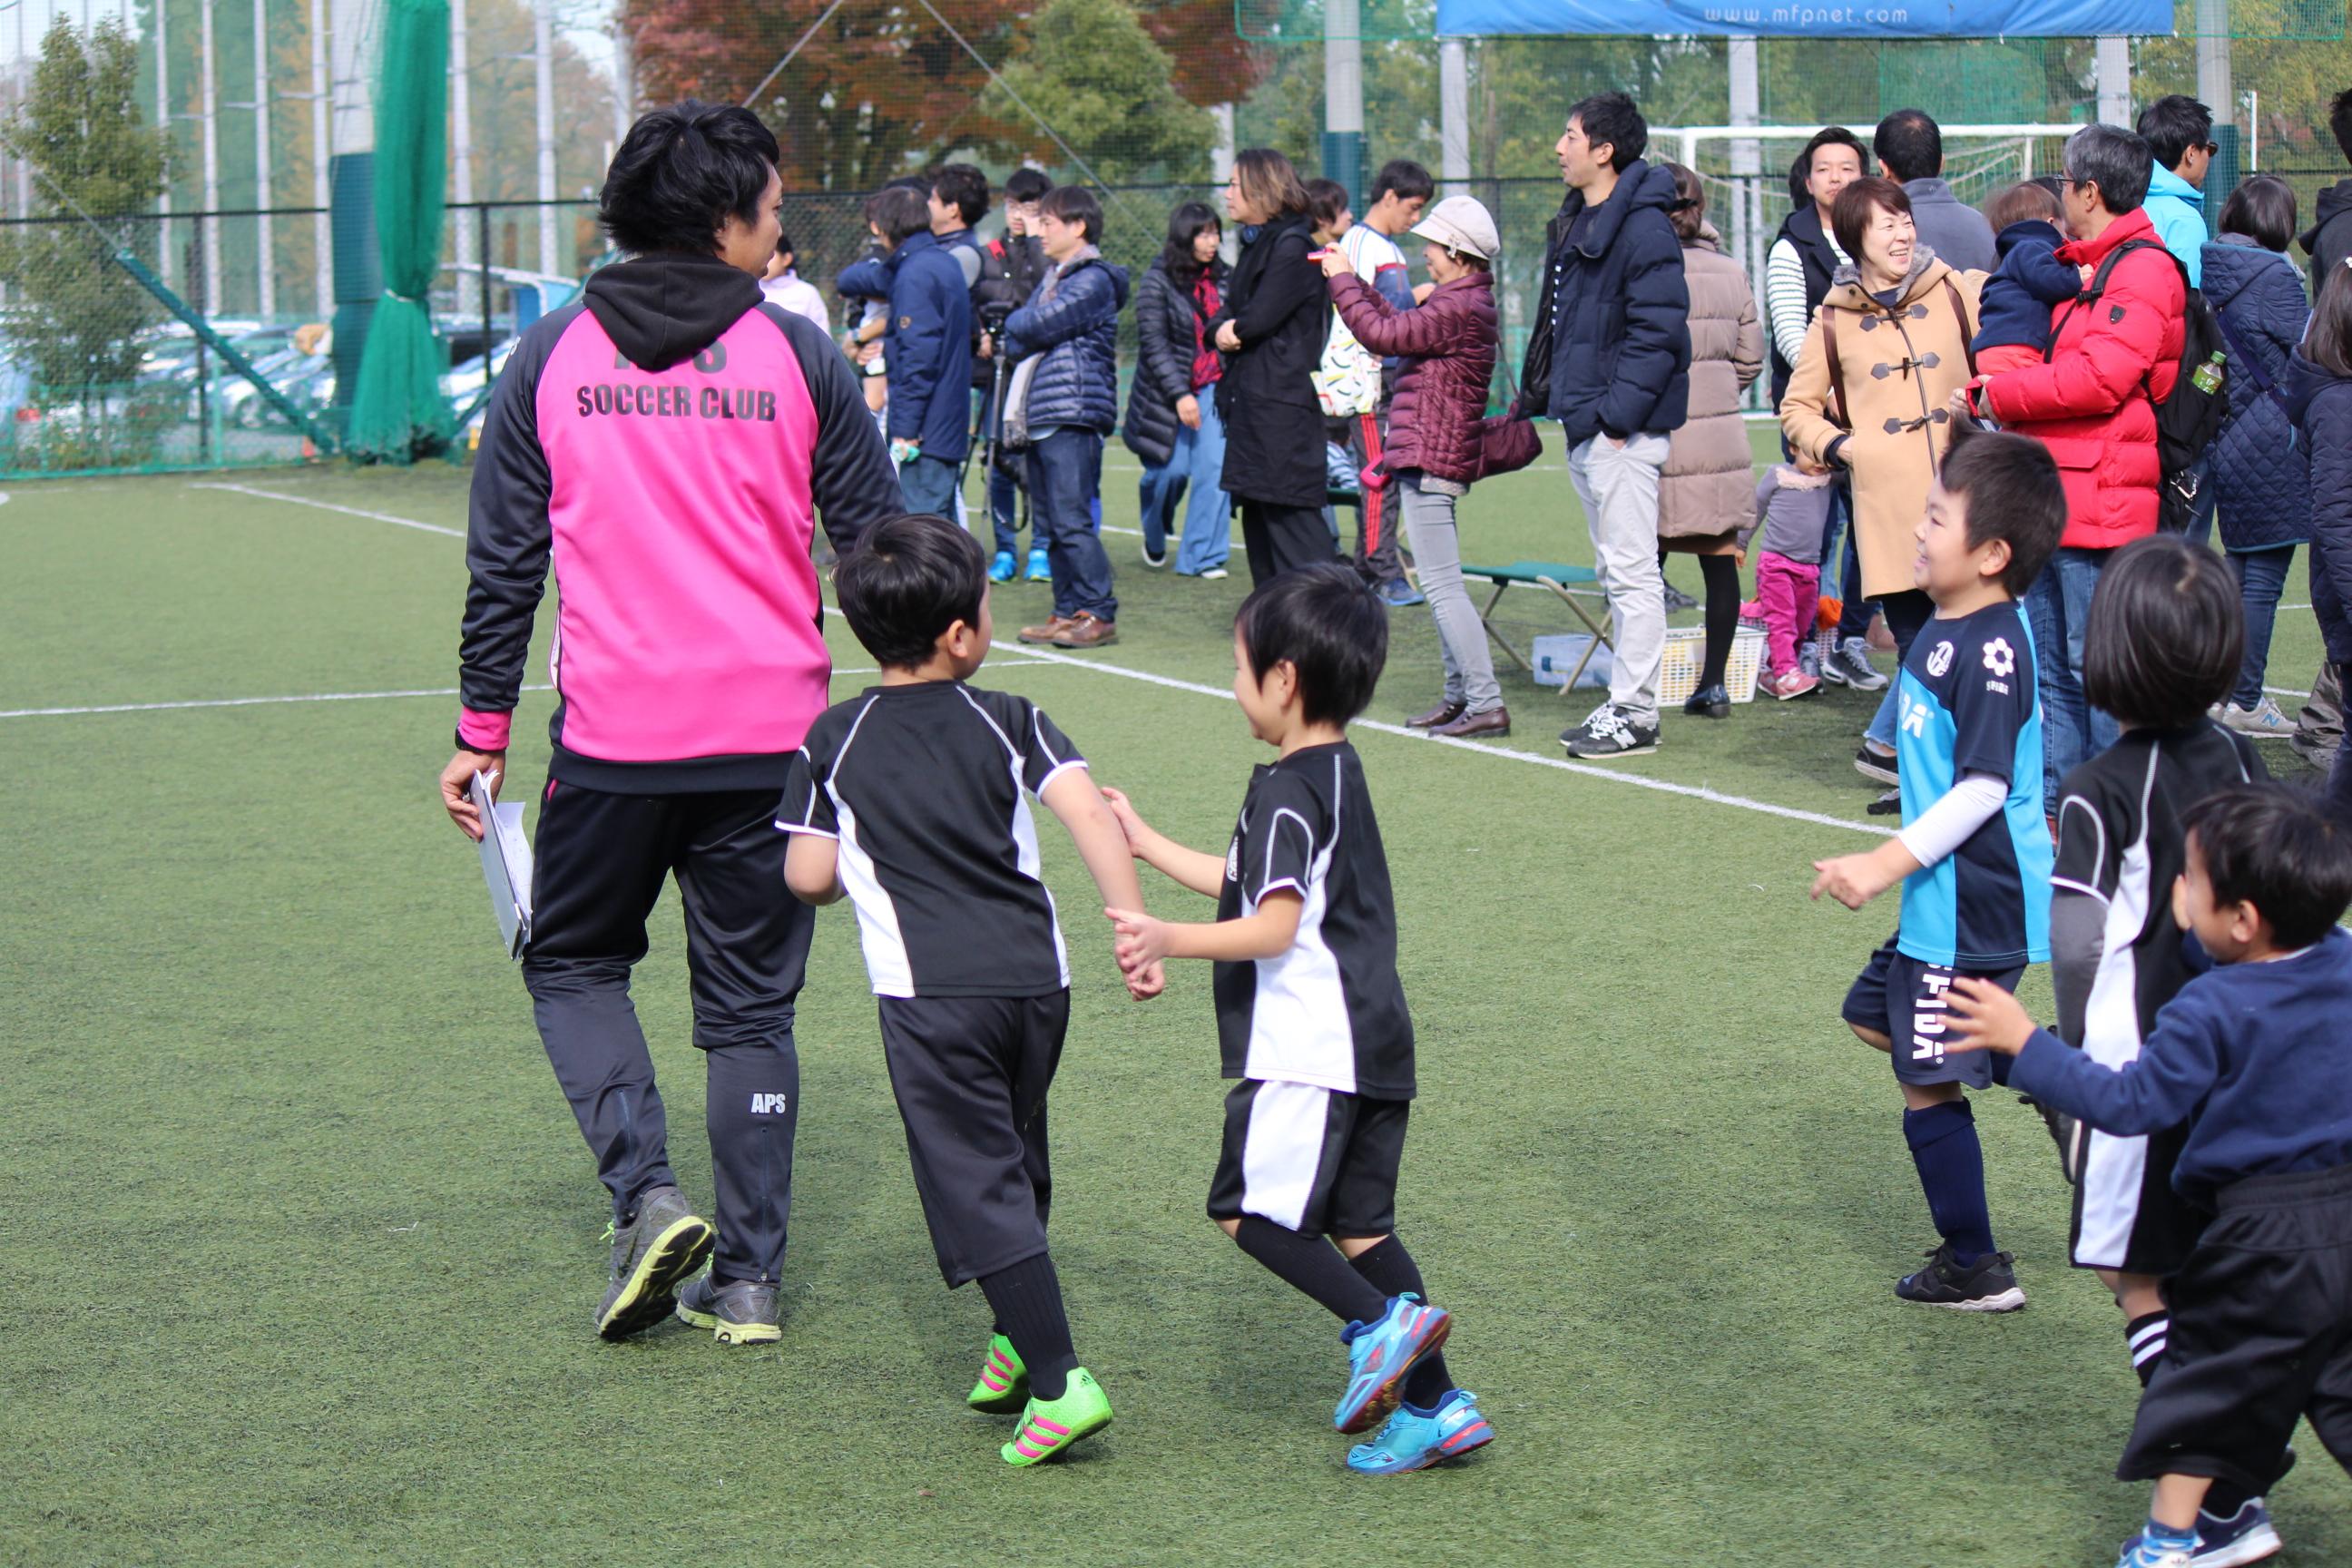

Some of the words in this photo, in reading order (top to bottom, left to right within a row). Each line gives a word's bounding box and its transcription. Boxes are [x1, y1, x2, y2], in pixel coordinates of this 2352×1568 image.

[1704, 5, 1908, 26] www.mfpnet.com
[576, 383, 691, 417] SOCCER
[699, 387, 777, 422] CLUB
[1912, 963, 1953, 1060] FIDA
[750, 1093, 786, 1114] APS
